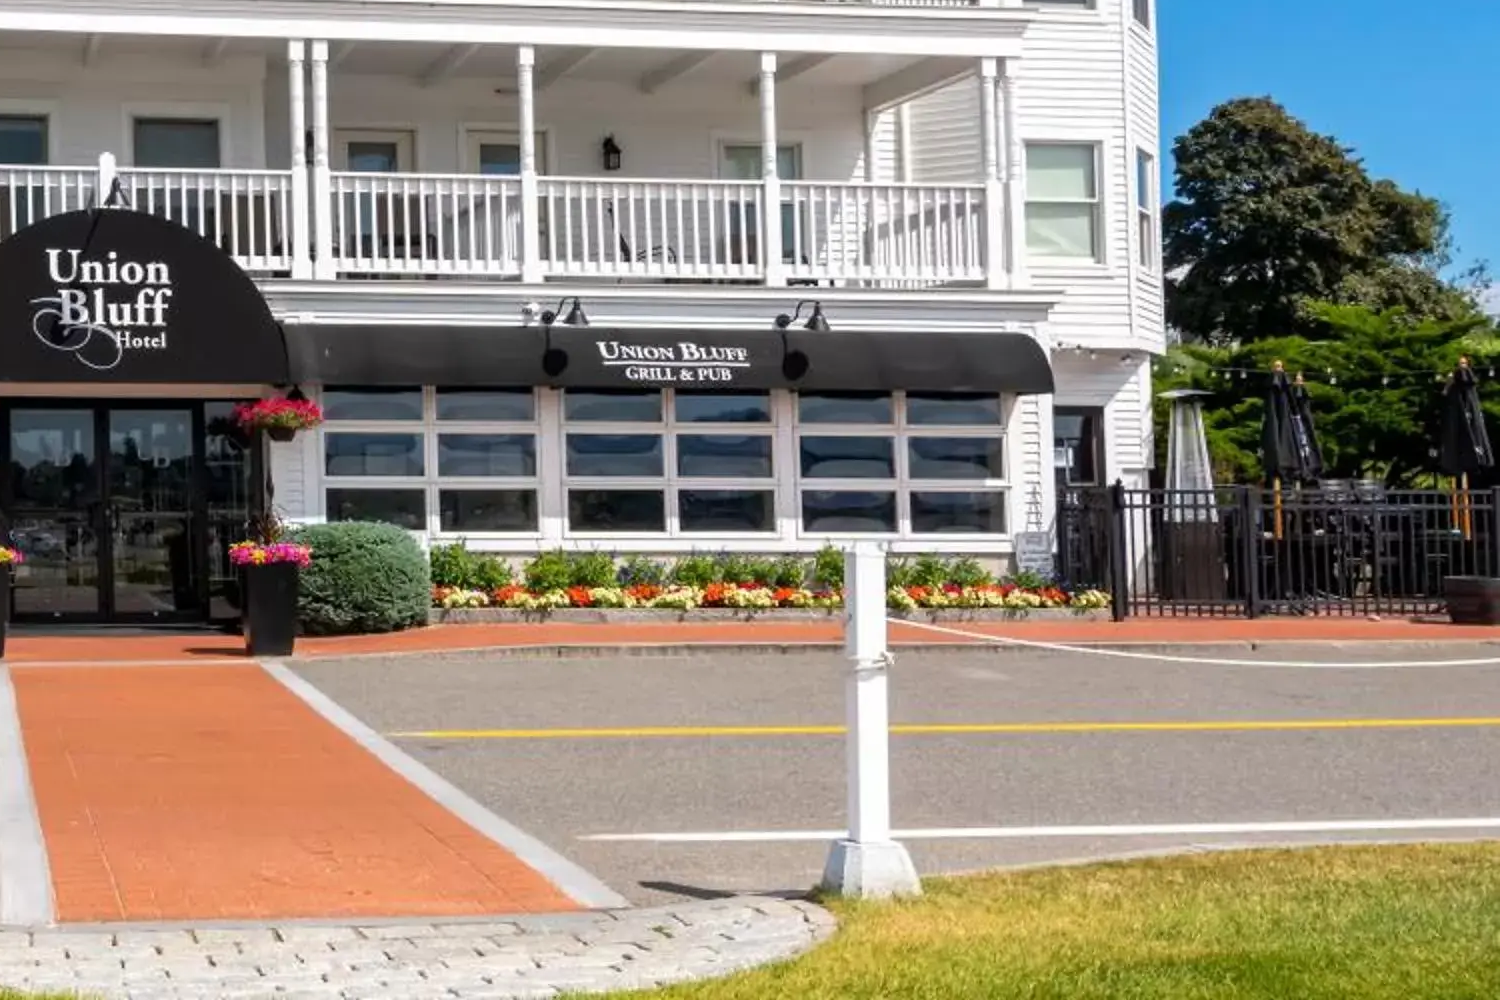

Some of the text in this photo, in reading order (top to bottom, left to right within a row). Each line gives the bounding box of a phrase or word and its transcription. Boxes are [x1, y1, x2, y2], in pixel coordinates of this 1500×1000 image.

[46, 249, 171, 284] Union
[58, 288, 172, 326] Bluff
[116, 331, 167, 350] Hotel
[596, 341, 747, 361] UNION BLUFF
[625, 366, 732, 381] GRILL & PUB
